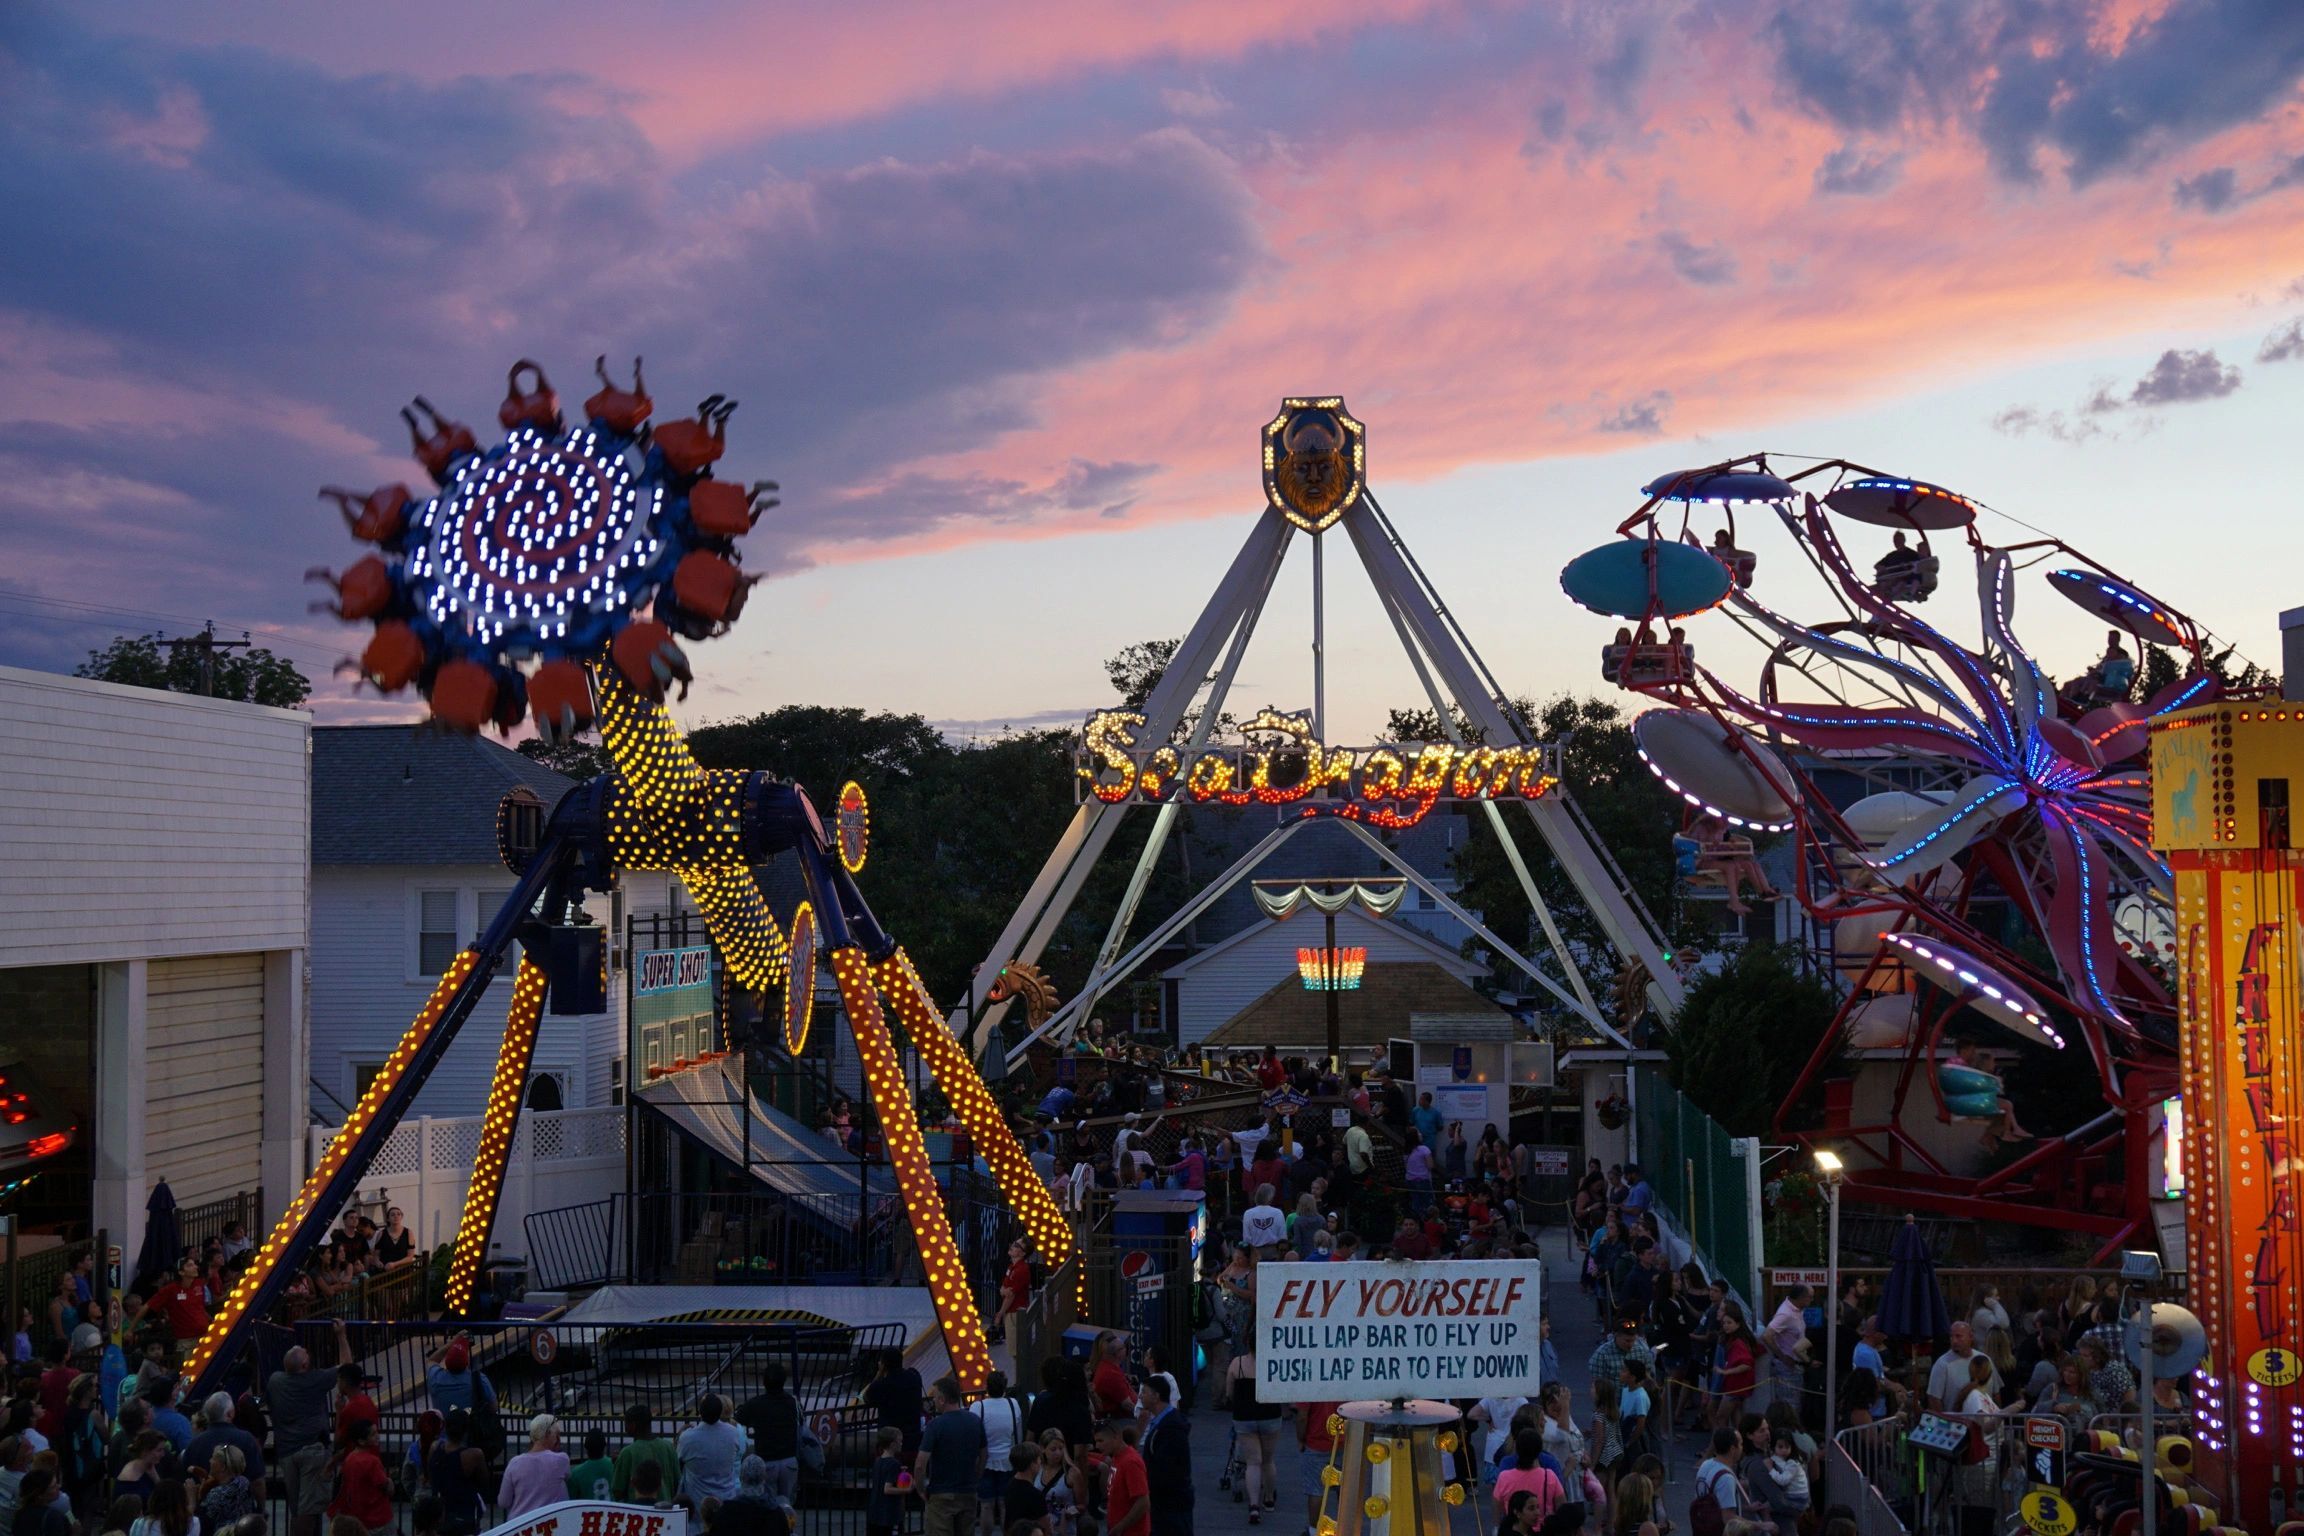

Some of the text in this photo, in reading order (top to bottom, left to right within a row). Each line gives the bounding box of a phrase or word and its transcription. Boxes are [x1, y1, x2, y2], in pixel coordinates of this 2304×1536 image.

[640, 949, 710, 991] SUPER SHOT!
[1138, 1278, 1162, 1289] EXIT ONLY
[1775, 1272, 1825, 1283] ENTER HERE
[1273, 1277, 1526, 1318] FLY YOURSELF
[536, 1333, 550, 1361] 6
[1272, 1323, 1518, 1349] PULL LAP BAR TO FLY UP
[1267, 1354, 1529, 1382] PUSH LAP BAR TO FLY DOWN
[2265, 1352, 2284, 1372] 3
[2256, 1371, 2295, 1383] TICKETS
[818, 1414, 832, 1445] 6
[2030, 1434, 2060, 1443] CHECKER
[2032, 1424, 2057, 1435] HEIGHT
[2039, 1495, 2059, 1521] 3
[579, 1511, 664, 1536] HERE
[2029, 1515, 2068, 1533] TICKETS
